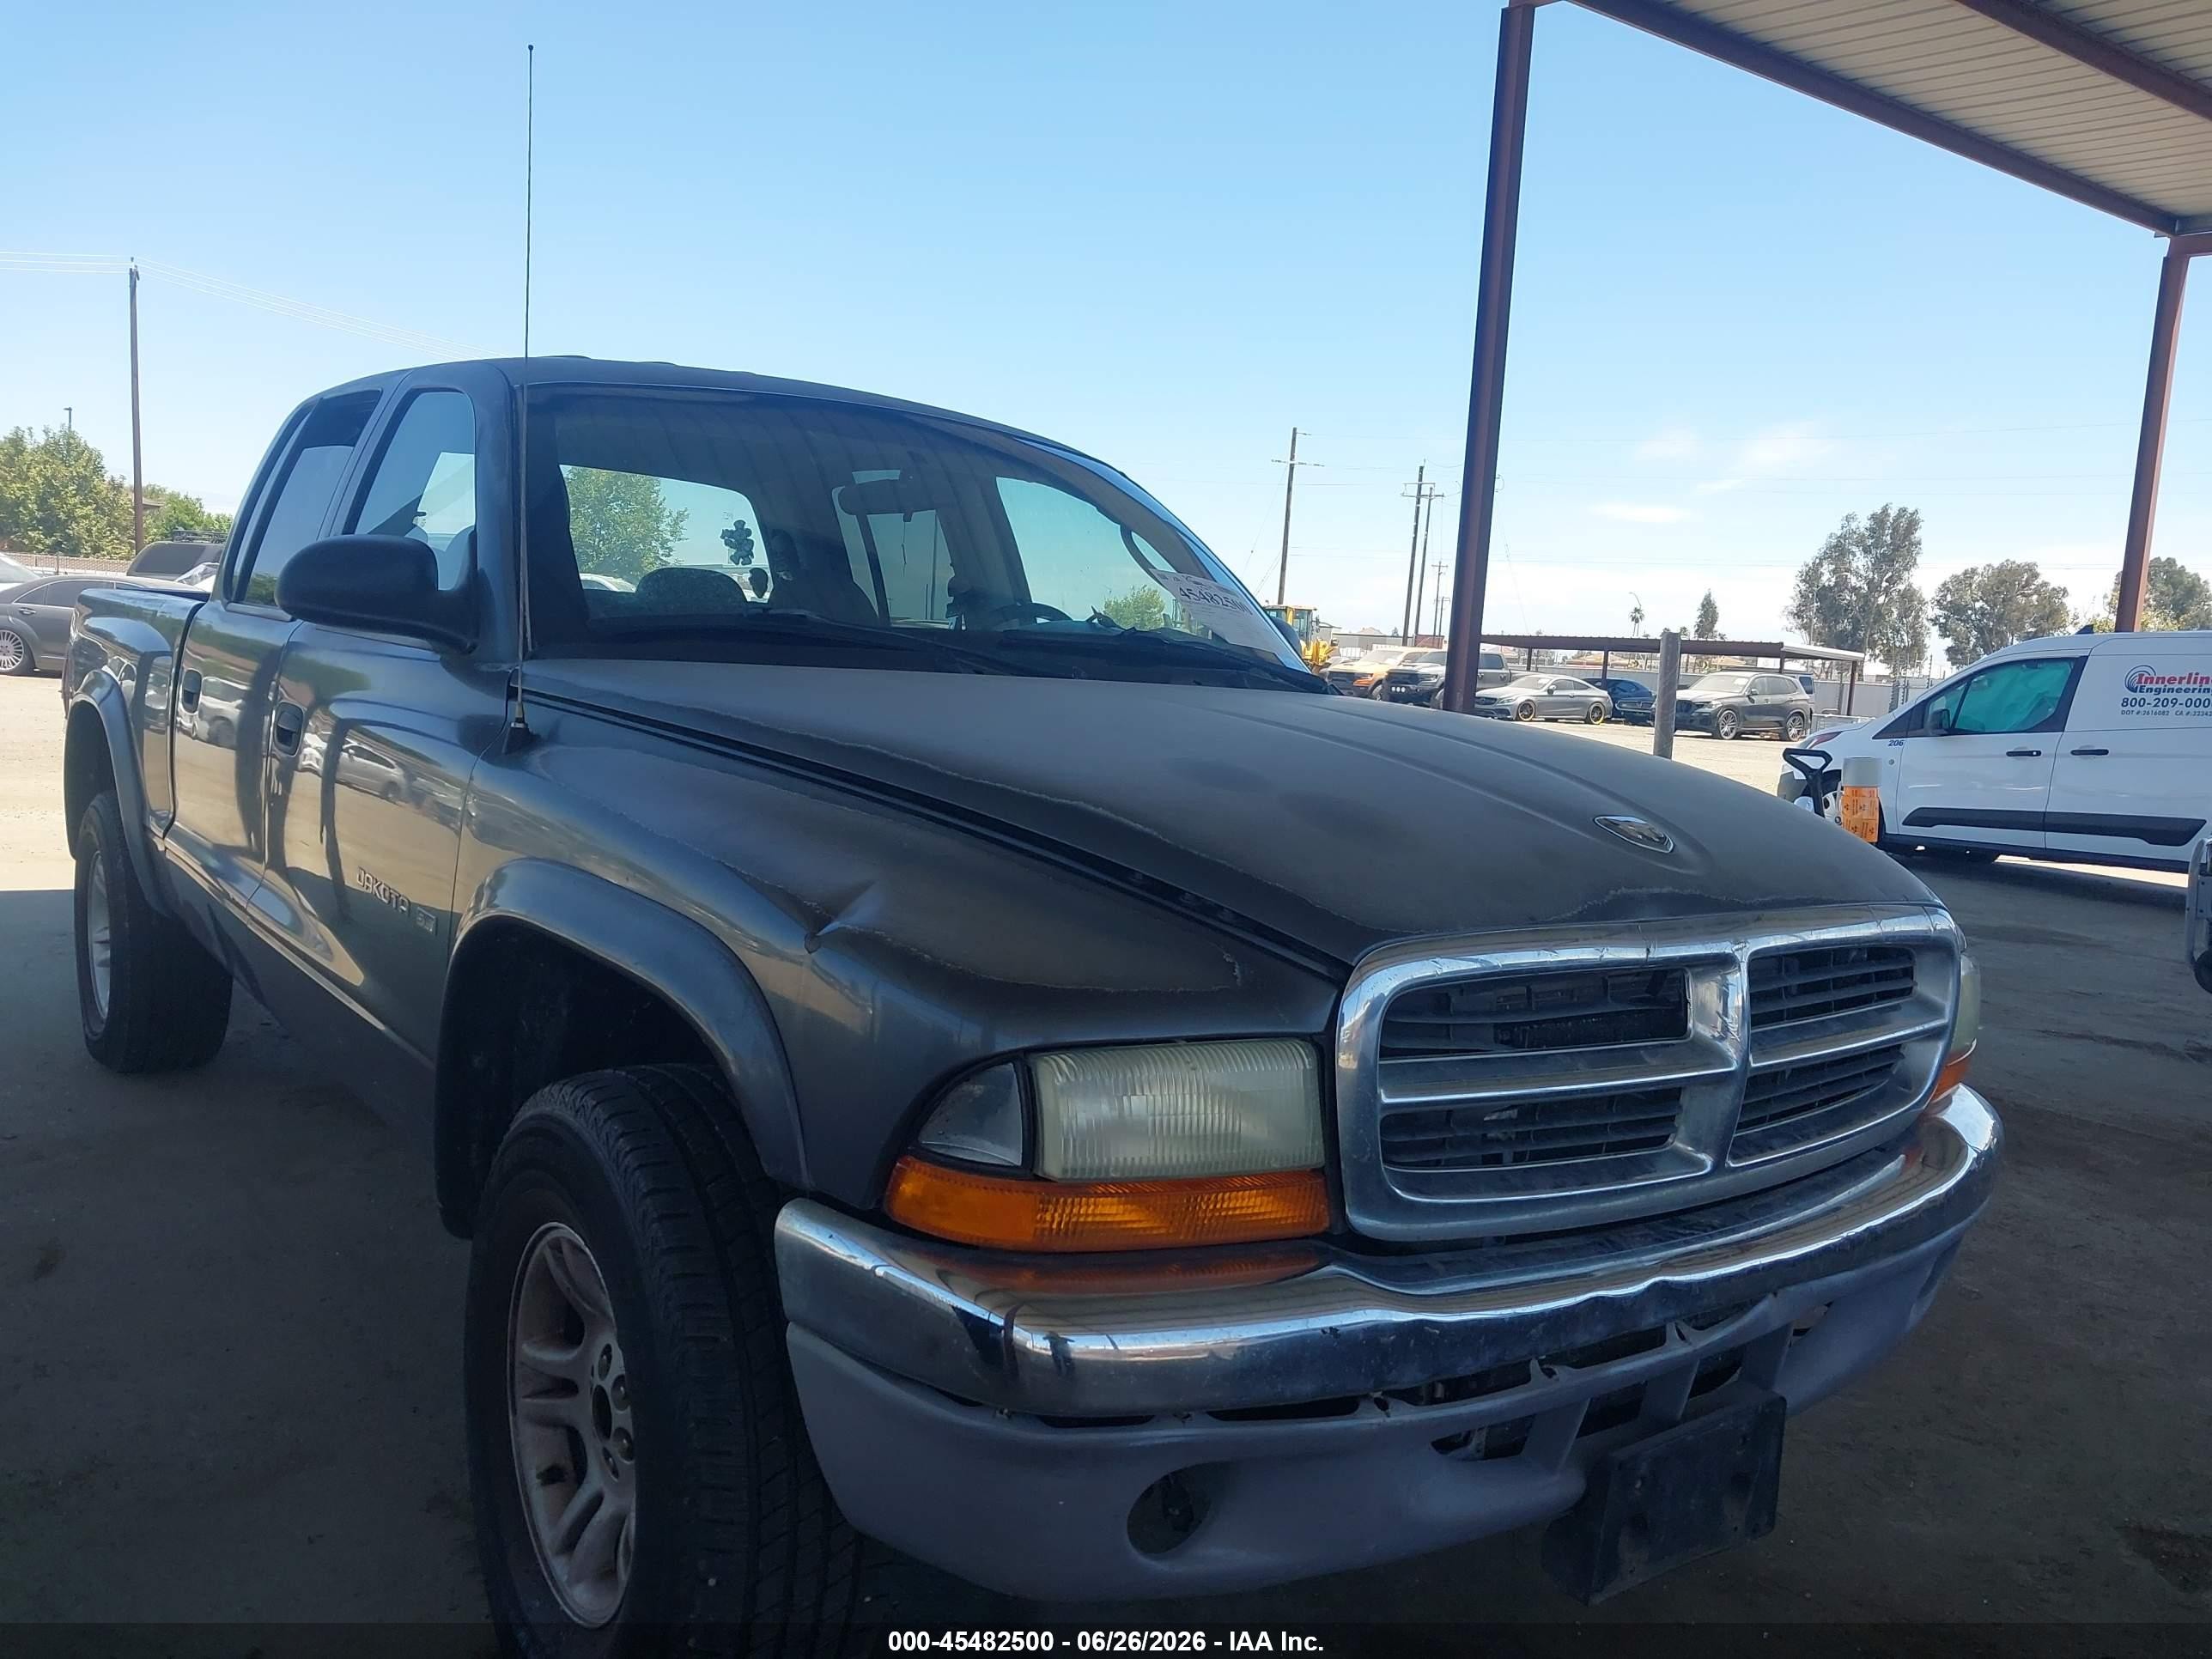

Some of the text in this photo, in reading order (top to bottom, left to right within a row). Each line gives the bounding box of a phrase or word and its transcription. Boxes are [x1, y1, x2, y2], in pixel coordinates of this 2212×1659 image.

[2136, 672, 2212, 685] Innerlin
[2138, 685, 2212, 696] Engineerin
[2121, 697, 2212, 708] 800-209-000
[356, 866, 410, 916] DAKOTA
